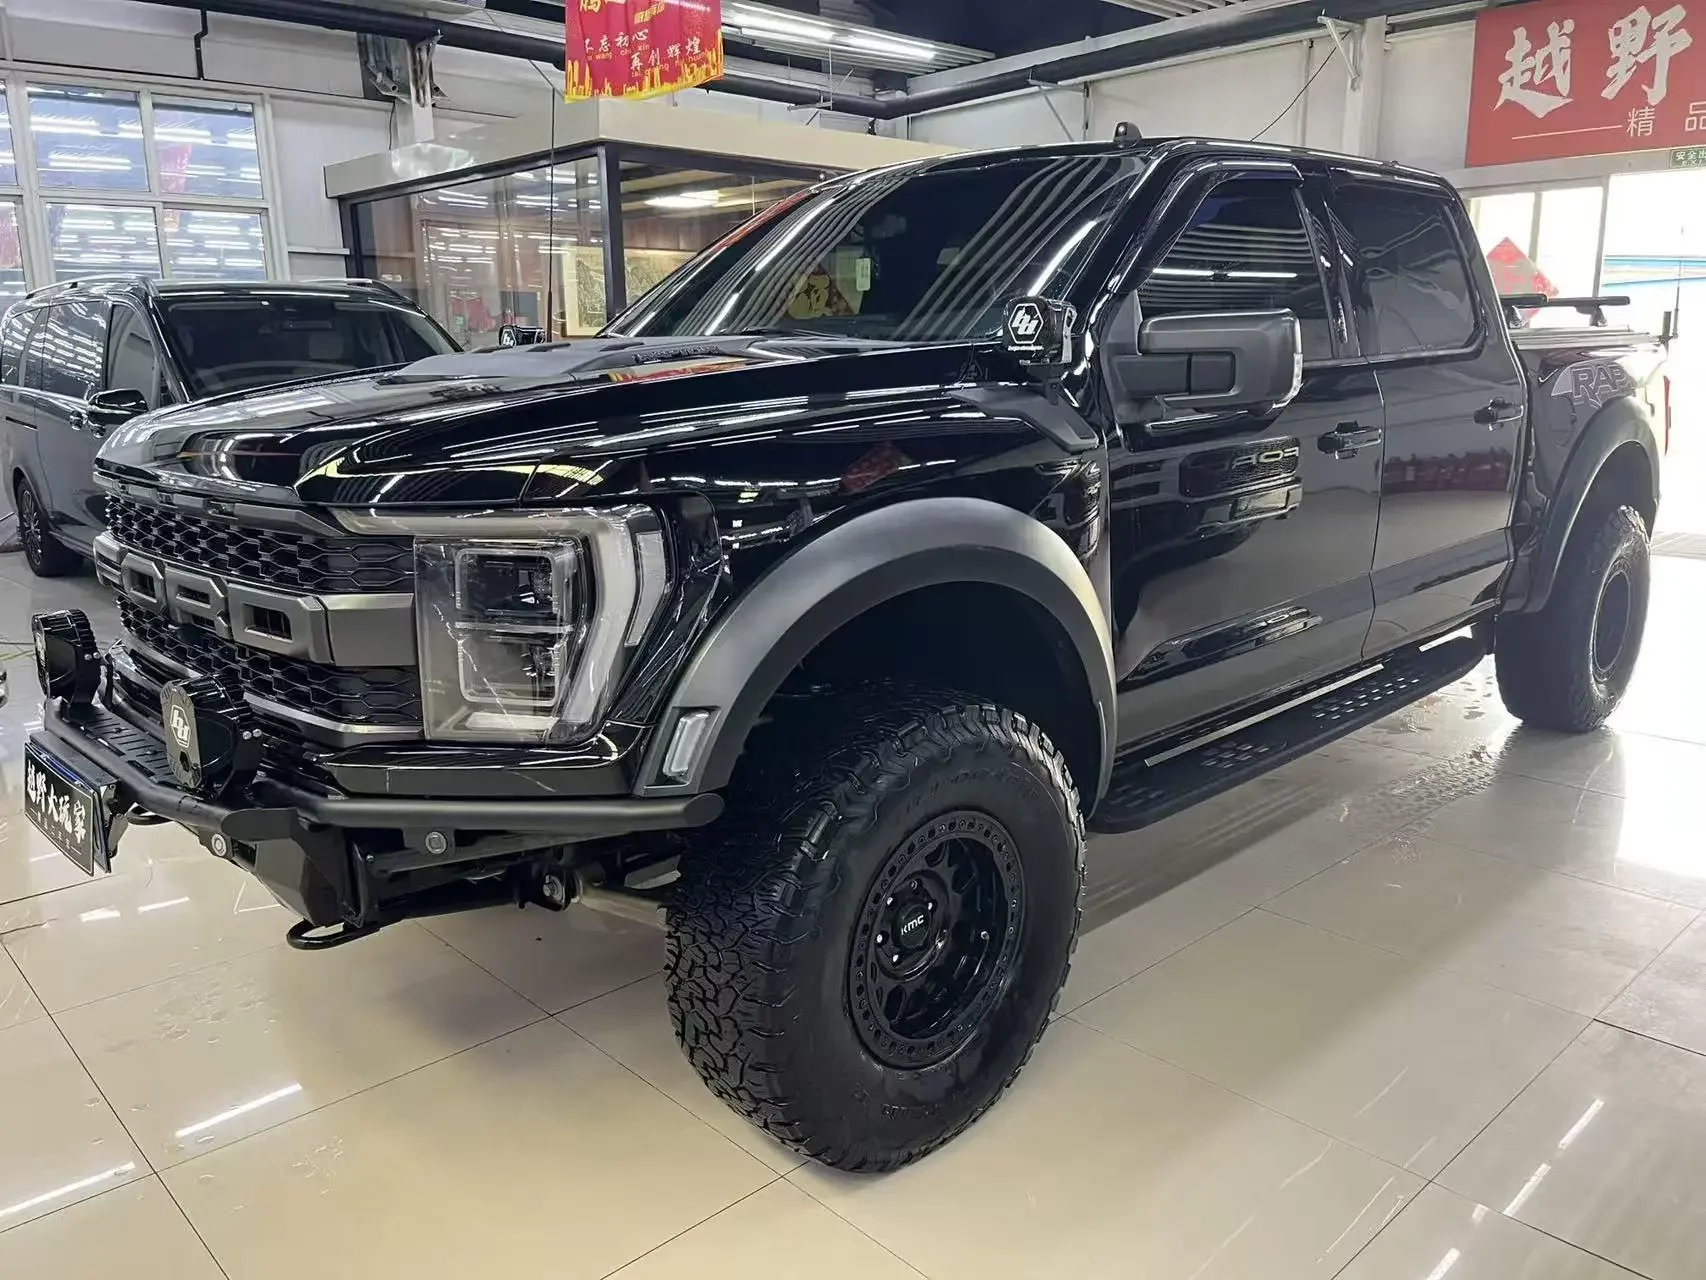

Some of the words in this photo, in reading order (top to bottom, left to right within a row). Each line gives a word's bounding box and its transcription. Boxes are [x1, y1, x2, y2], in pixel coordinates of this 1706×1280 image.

[630, 36, 701, 72] 再创辉煌
[1491, 4, 1693, 119] 越野
[1626, 100, 1706, 138] 精品
